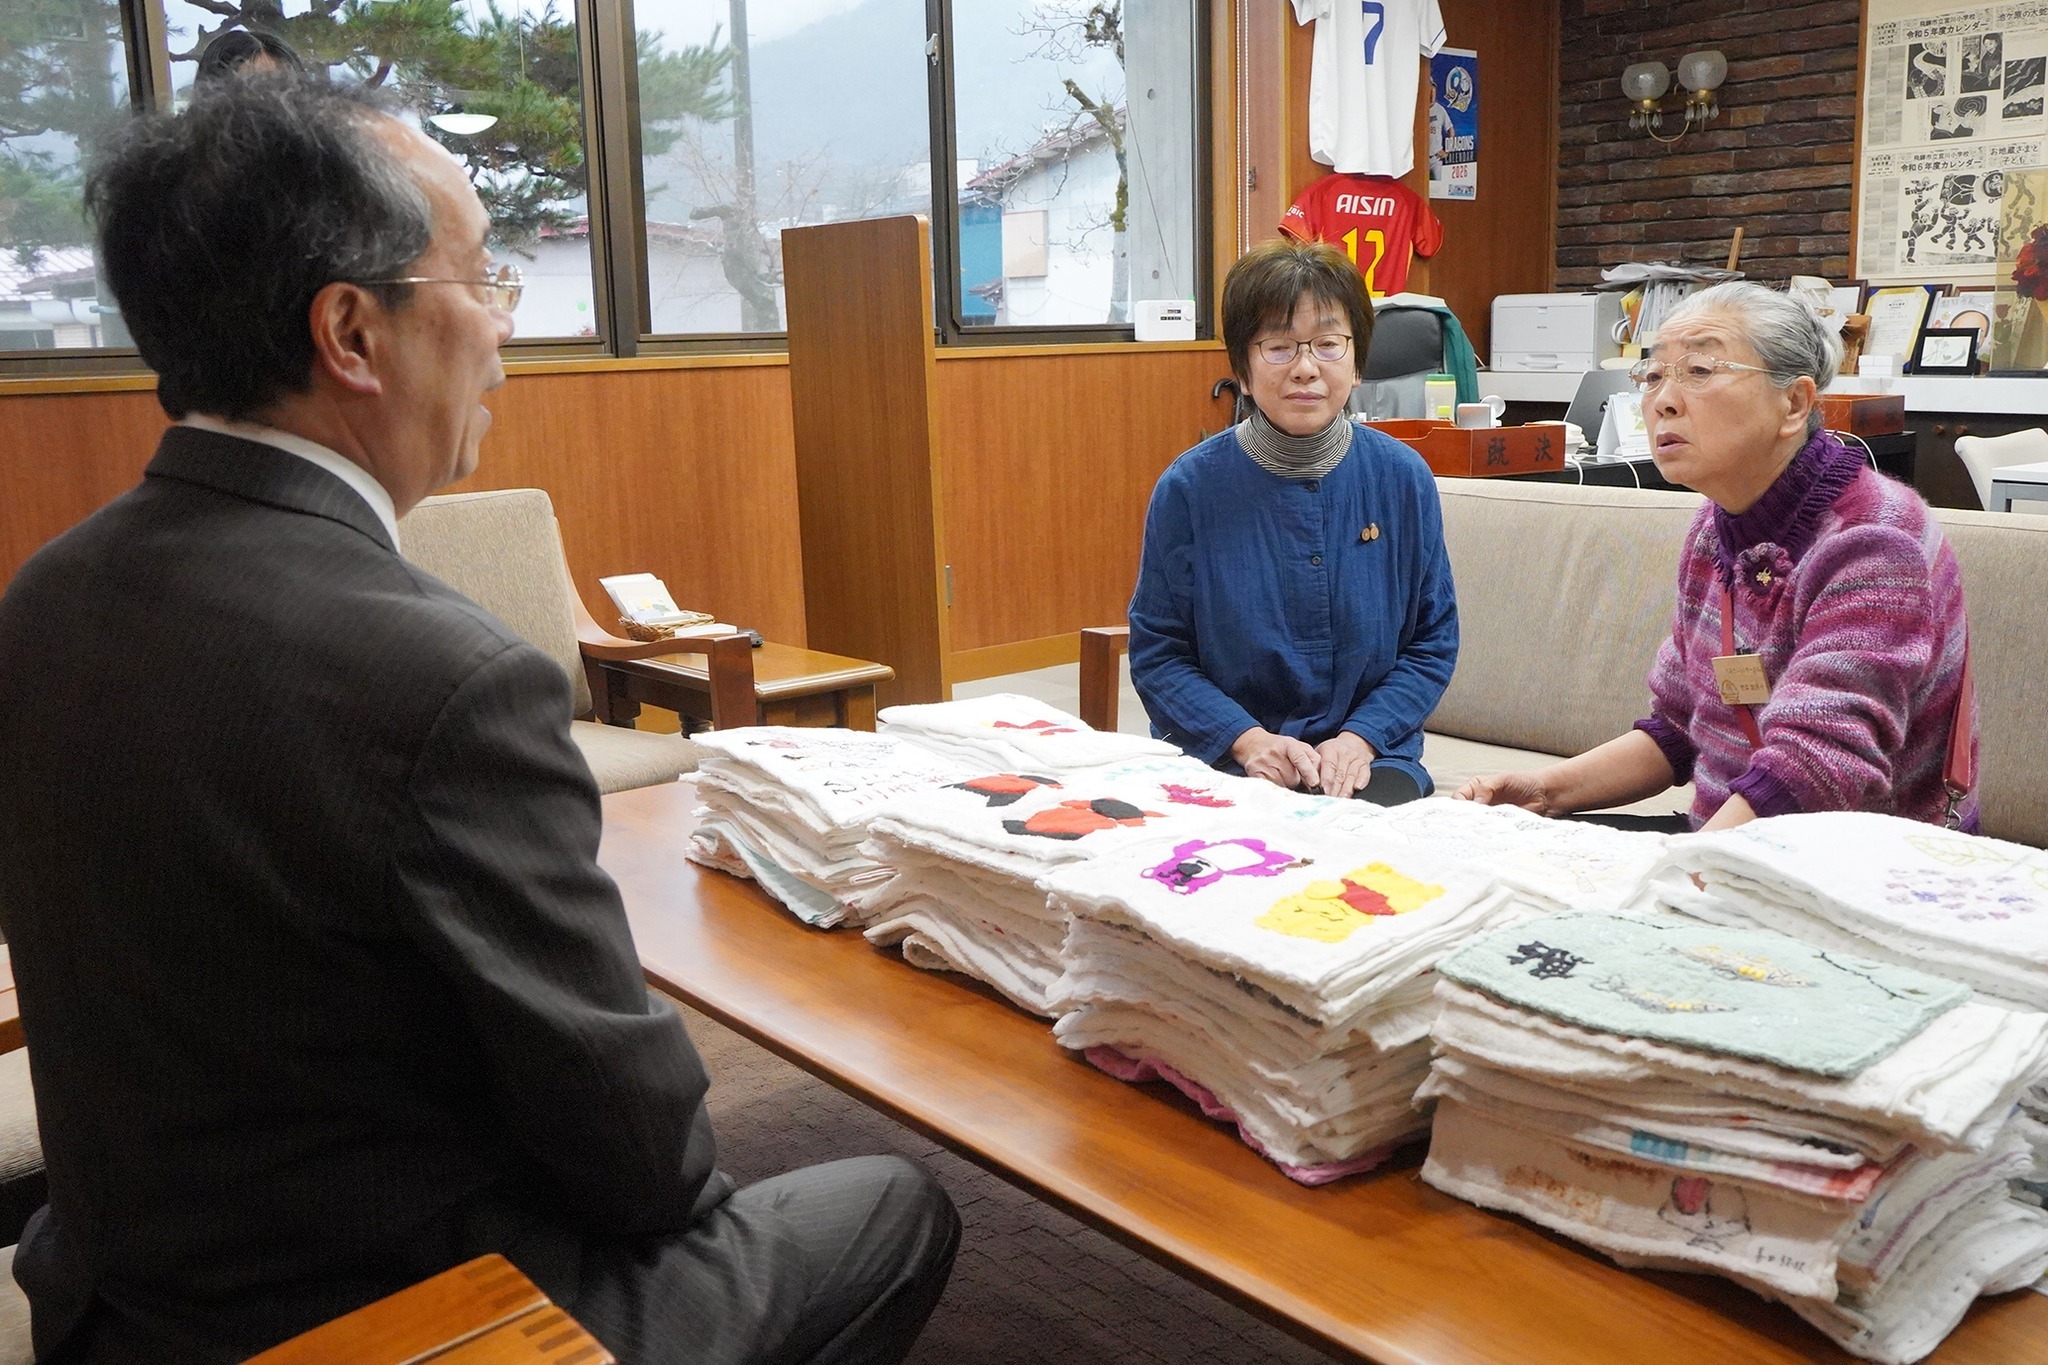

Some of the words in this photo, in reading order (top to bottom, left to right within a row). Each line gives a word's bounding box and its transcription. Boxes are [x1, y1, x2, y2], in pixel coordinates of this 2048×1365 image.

[1362, 1, 1384, 65] 7
[1445, 135, 1475, 152] DRAGONS
[1451, 165, 1469, 179] 2026
[1336, 194, 1396, 217] AISIN
[1341, 226, 1386, 298] 12
